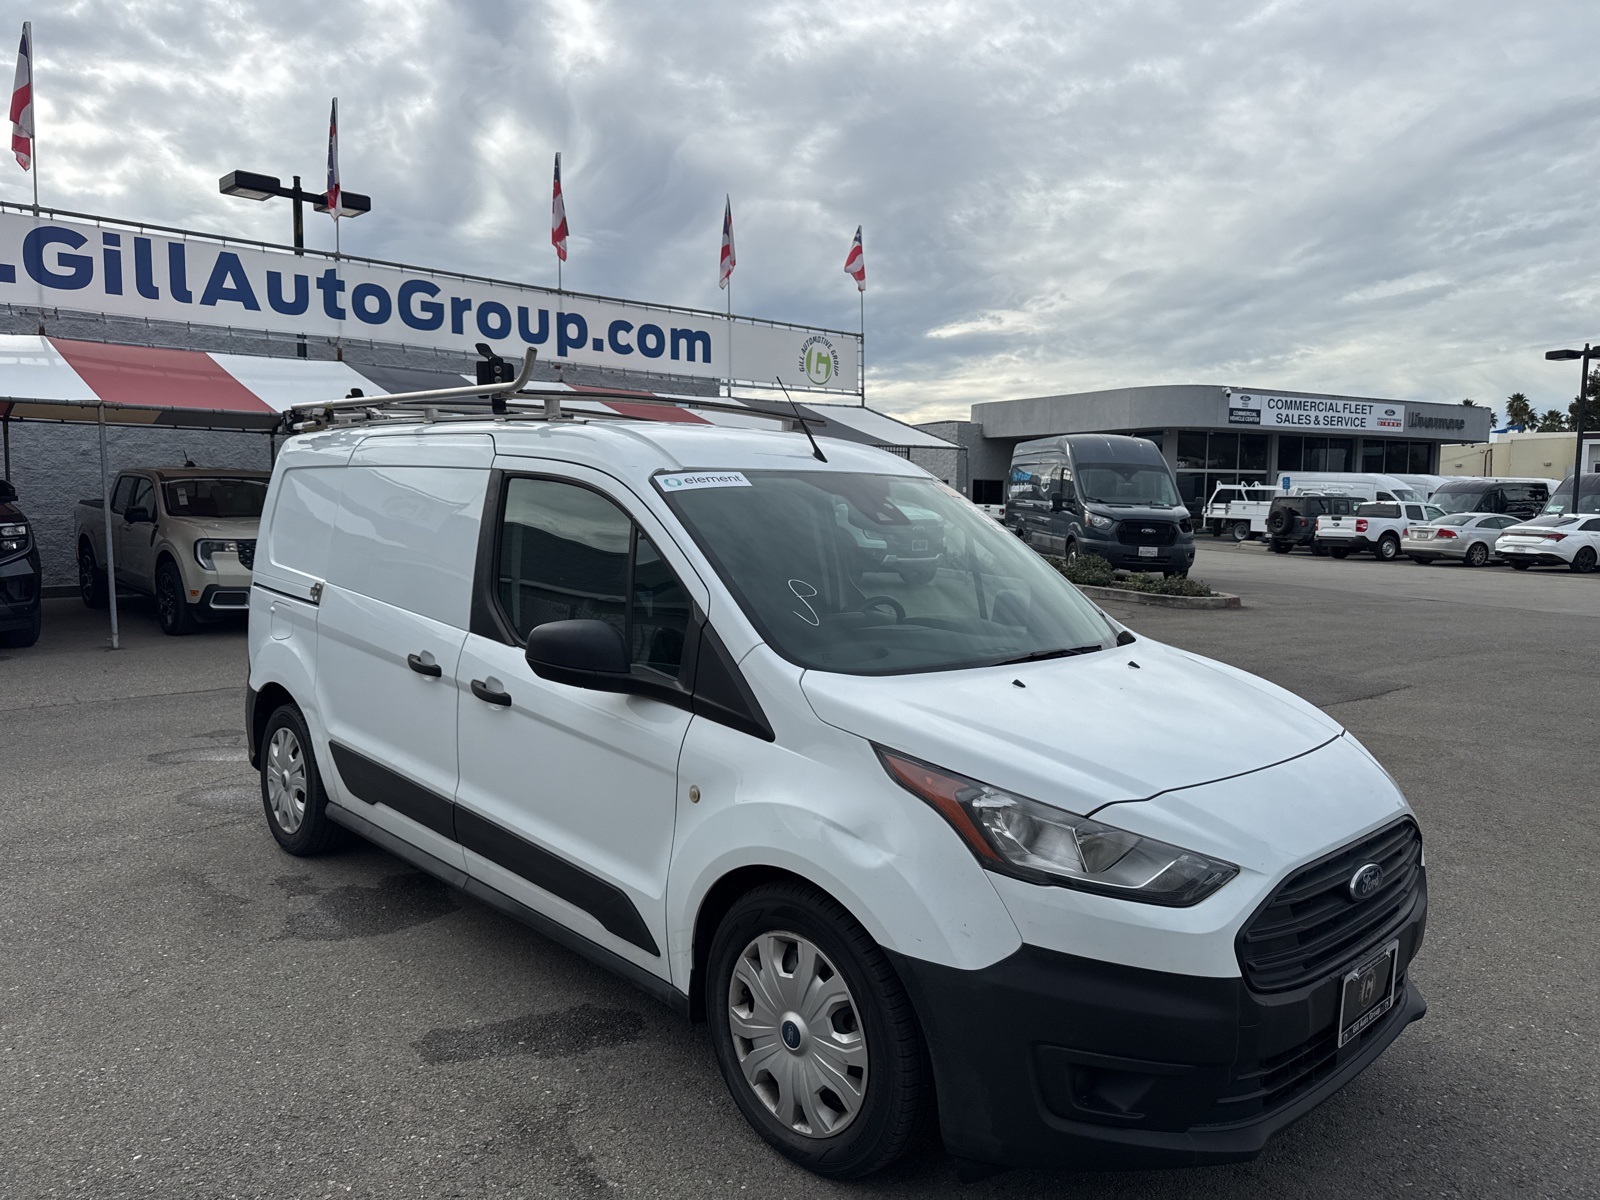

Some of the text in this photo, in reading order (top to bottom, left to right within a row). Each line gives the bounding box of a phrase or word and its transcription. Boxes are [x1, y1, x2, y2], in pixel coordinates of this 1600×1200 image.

[801, 335, 833, 355] AUTOMOTIVE
[831, 349, 839, 377] GROUP
[1267, 398, 1374, 415] COMMERCIAL FLEET
[1275, 413, 1367, 428] SALES & SERVICE
[684, 475, 743, 484] element
[1362, 869, 1380, 893] Ford
[1369, 1007, 1381, 1021] Group
